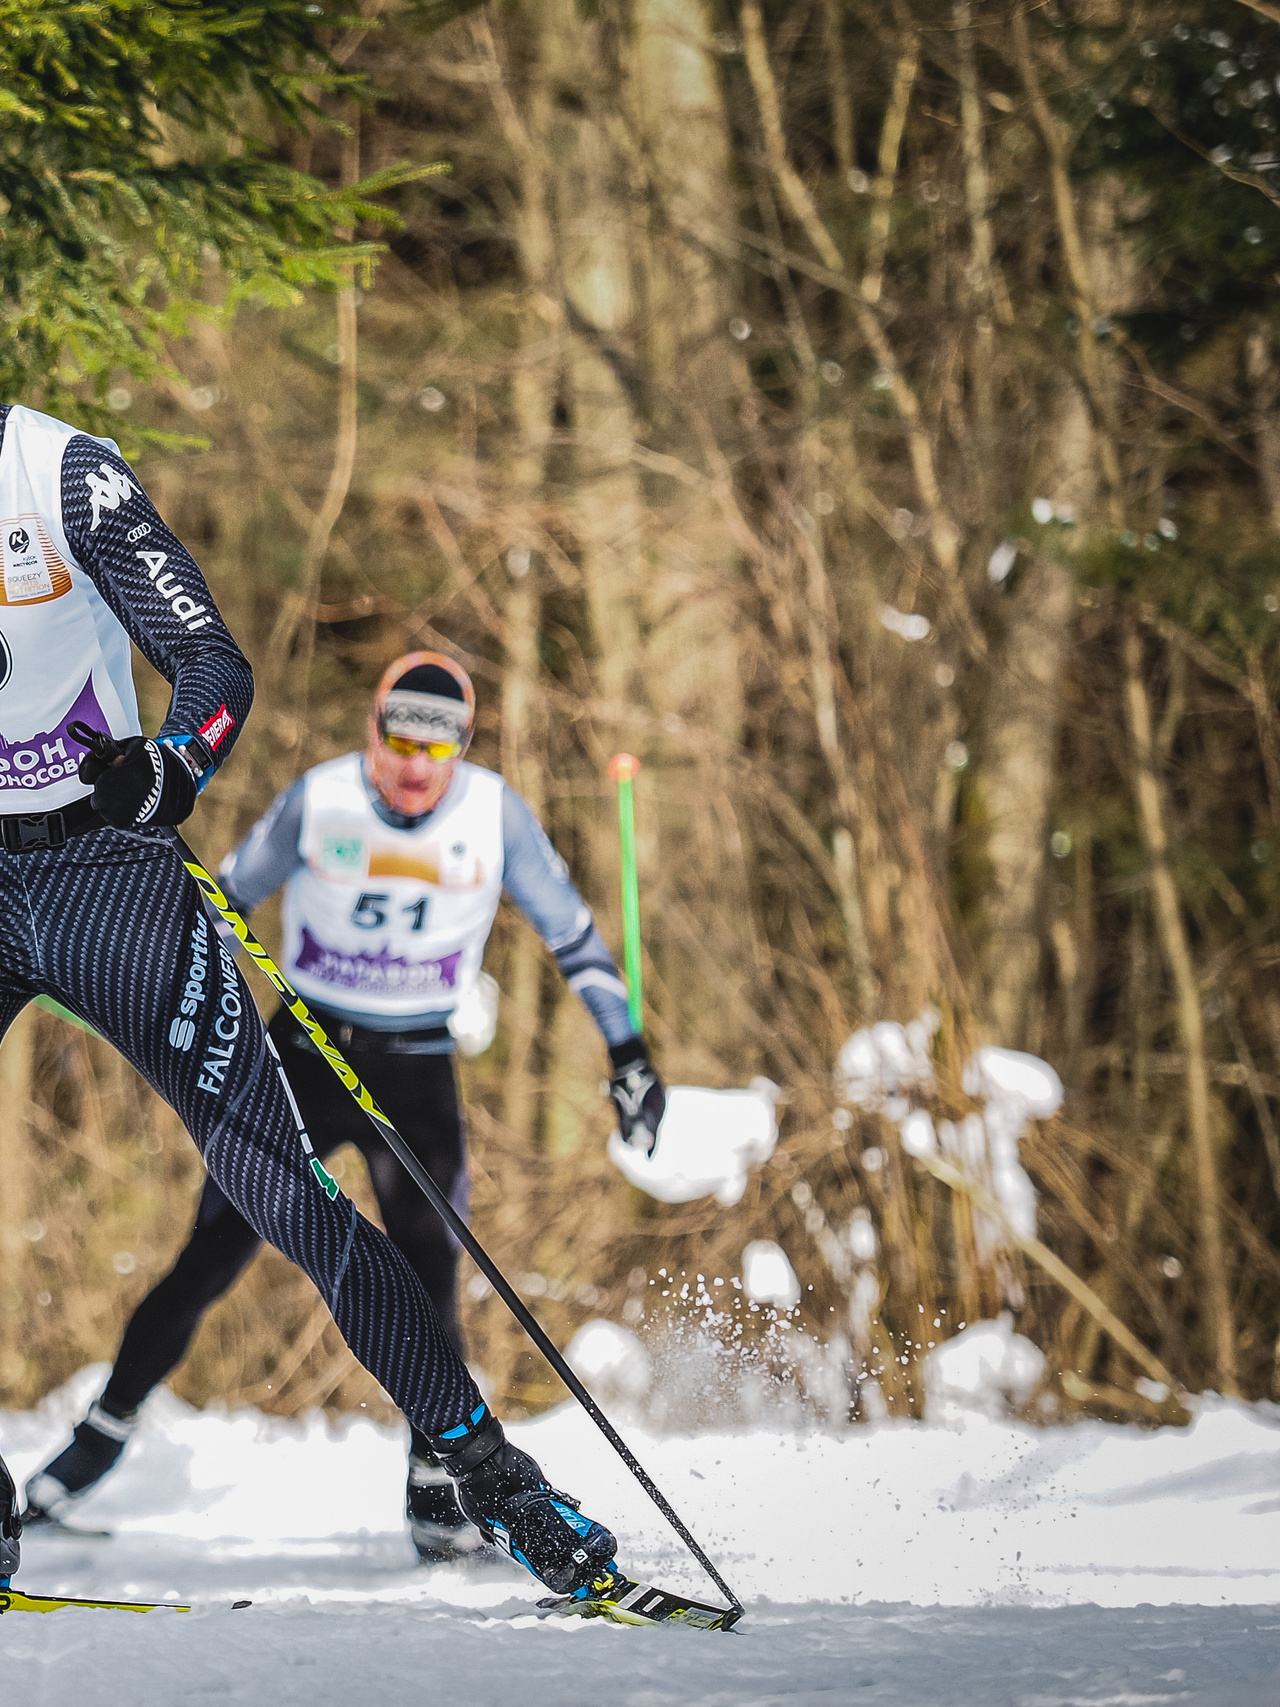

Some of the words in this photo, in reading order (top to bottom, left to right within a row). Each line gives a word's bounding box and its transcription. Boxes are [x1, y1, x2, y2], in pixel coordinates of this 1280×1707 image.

[135, 551, 213, 632] Audi
[350, 892, 430, 931] 51
[180, 910, 209, 1017] sportful
[196, 939, 243, 1096] FALCONERI
